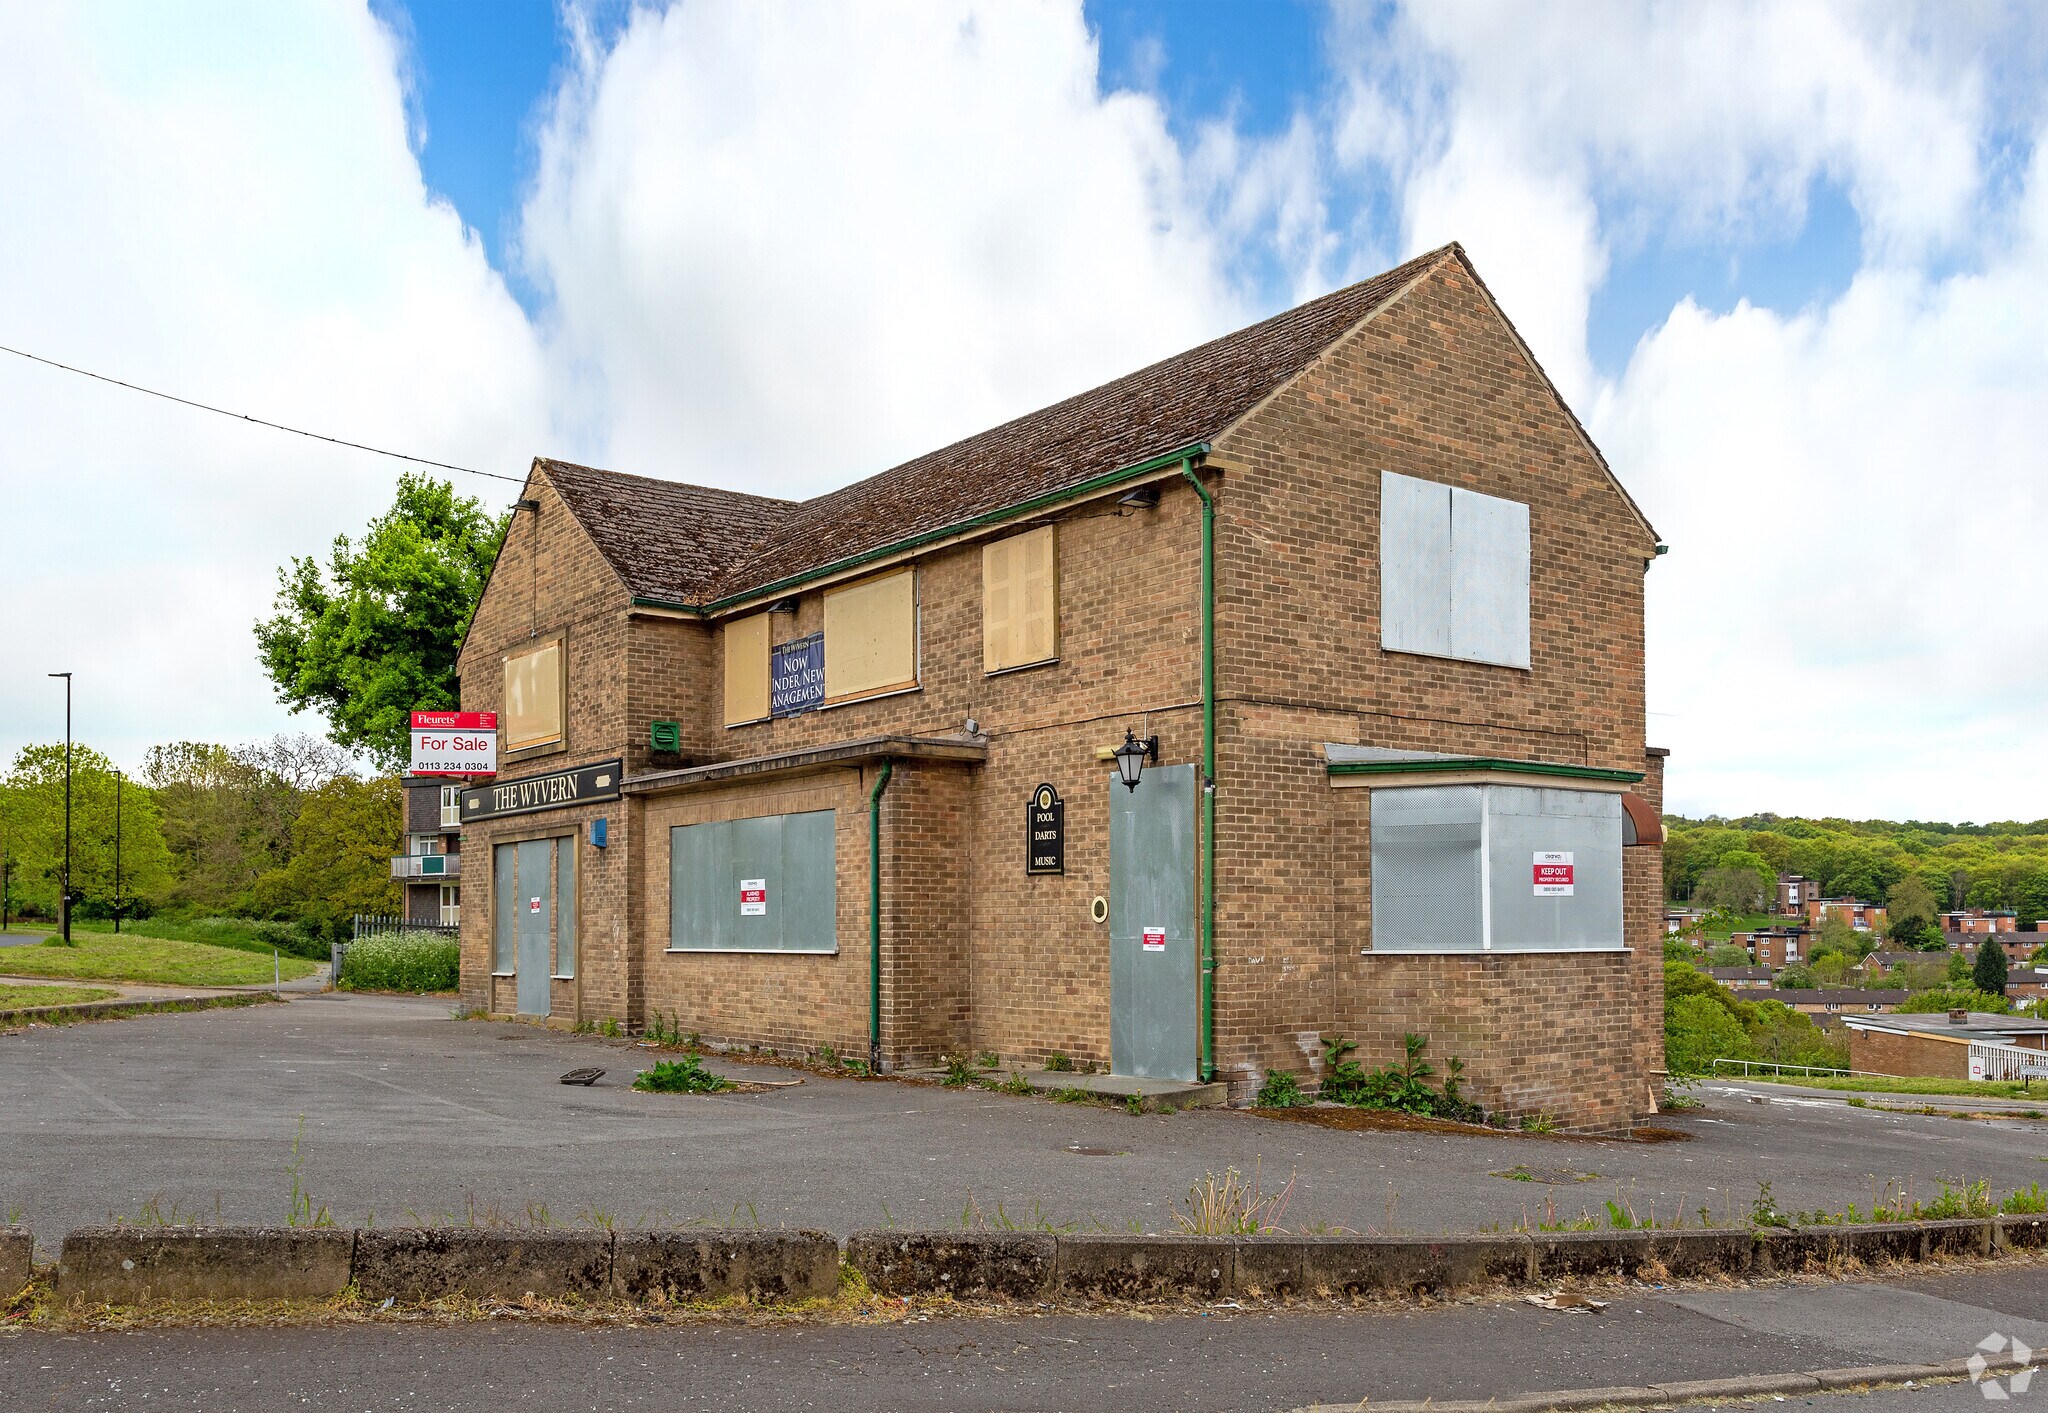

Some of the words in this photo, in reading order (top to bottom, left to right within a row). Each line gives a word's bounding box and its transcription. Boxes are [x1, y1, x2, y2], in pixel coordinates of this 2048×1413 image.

[784, 656, 808, 674] NOW
[803, 668, 825, 685] NEW
[418, 714, 455, 724] Fleurets
[421, 736, 448, 751] For
[453, 736, 488, 751] Sale
[418, 761, 441, 770] 0113
[443, 762, 462, 770] 234
[464, 762, 488, 771] 0304
[494, 785, 518, 811] THE
[520, 774, 579, 806] WYVERN
[1037, 812, 1055, 822] POOL
[1035, 831, 1057, 841] DARTS
[1035, 856, 1056, 866] MUSIC
[1541, 867, 1554, 875] KEEP
[1555, 867, 1567, 875] OUT
